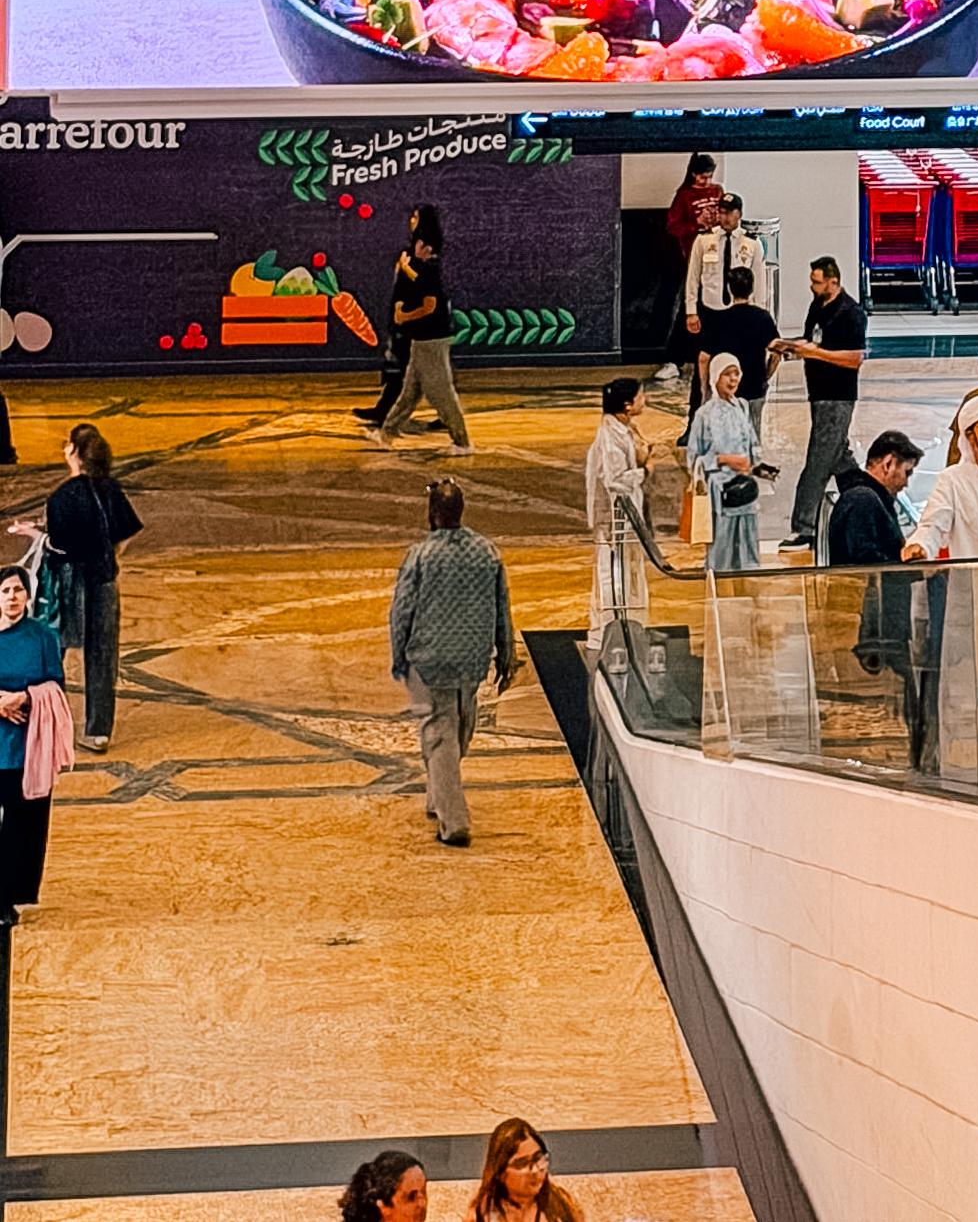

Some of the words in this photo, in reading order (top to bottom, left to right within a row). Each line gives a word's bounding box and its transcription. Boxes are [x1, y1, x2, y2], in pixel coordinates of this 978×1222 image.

[860, 116, 890, 128] Food
[892, 115, 925, 128] Court
[332, 129, 403, 160] طازجة
[332, 156, 397, 186] Fresh
[405, 133, 507, 171] Produce
